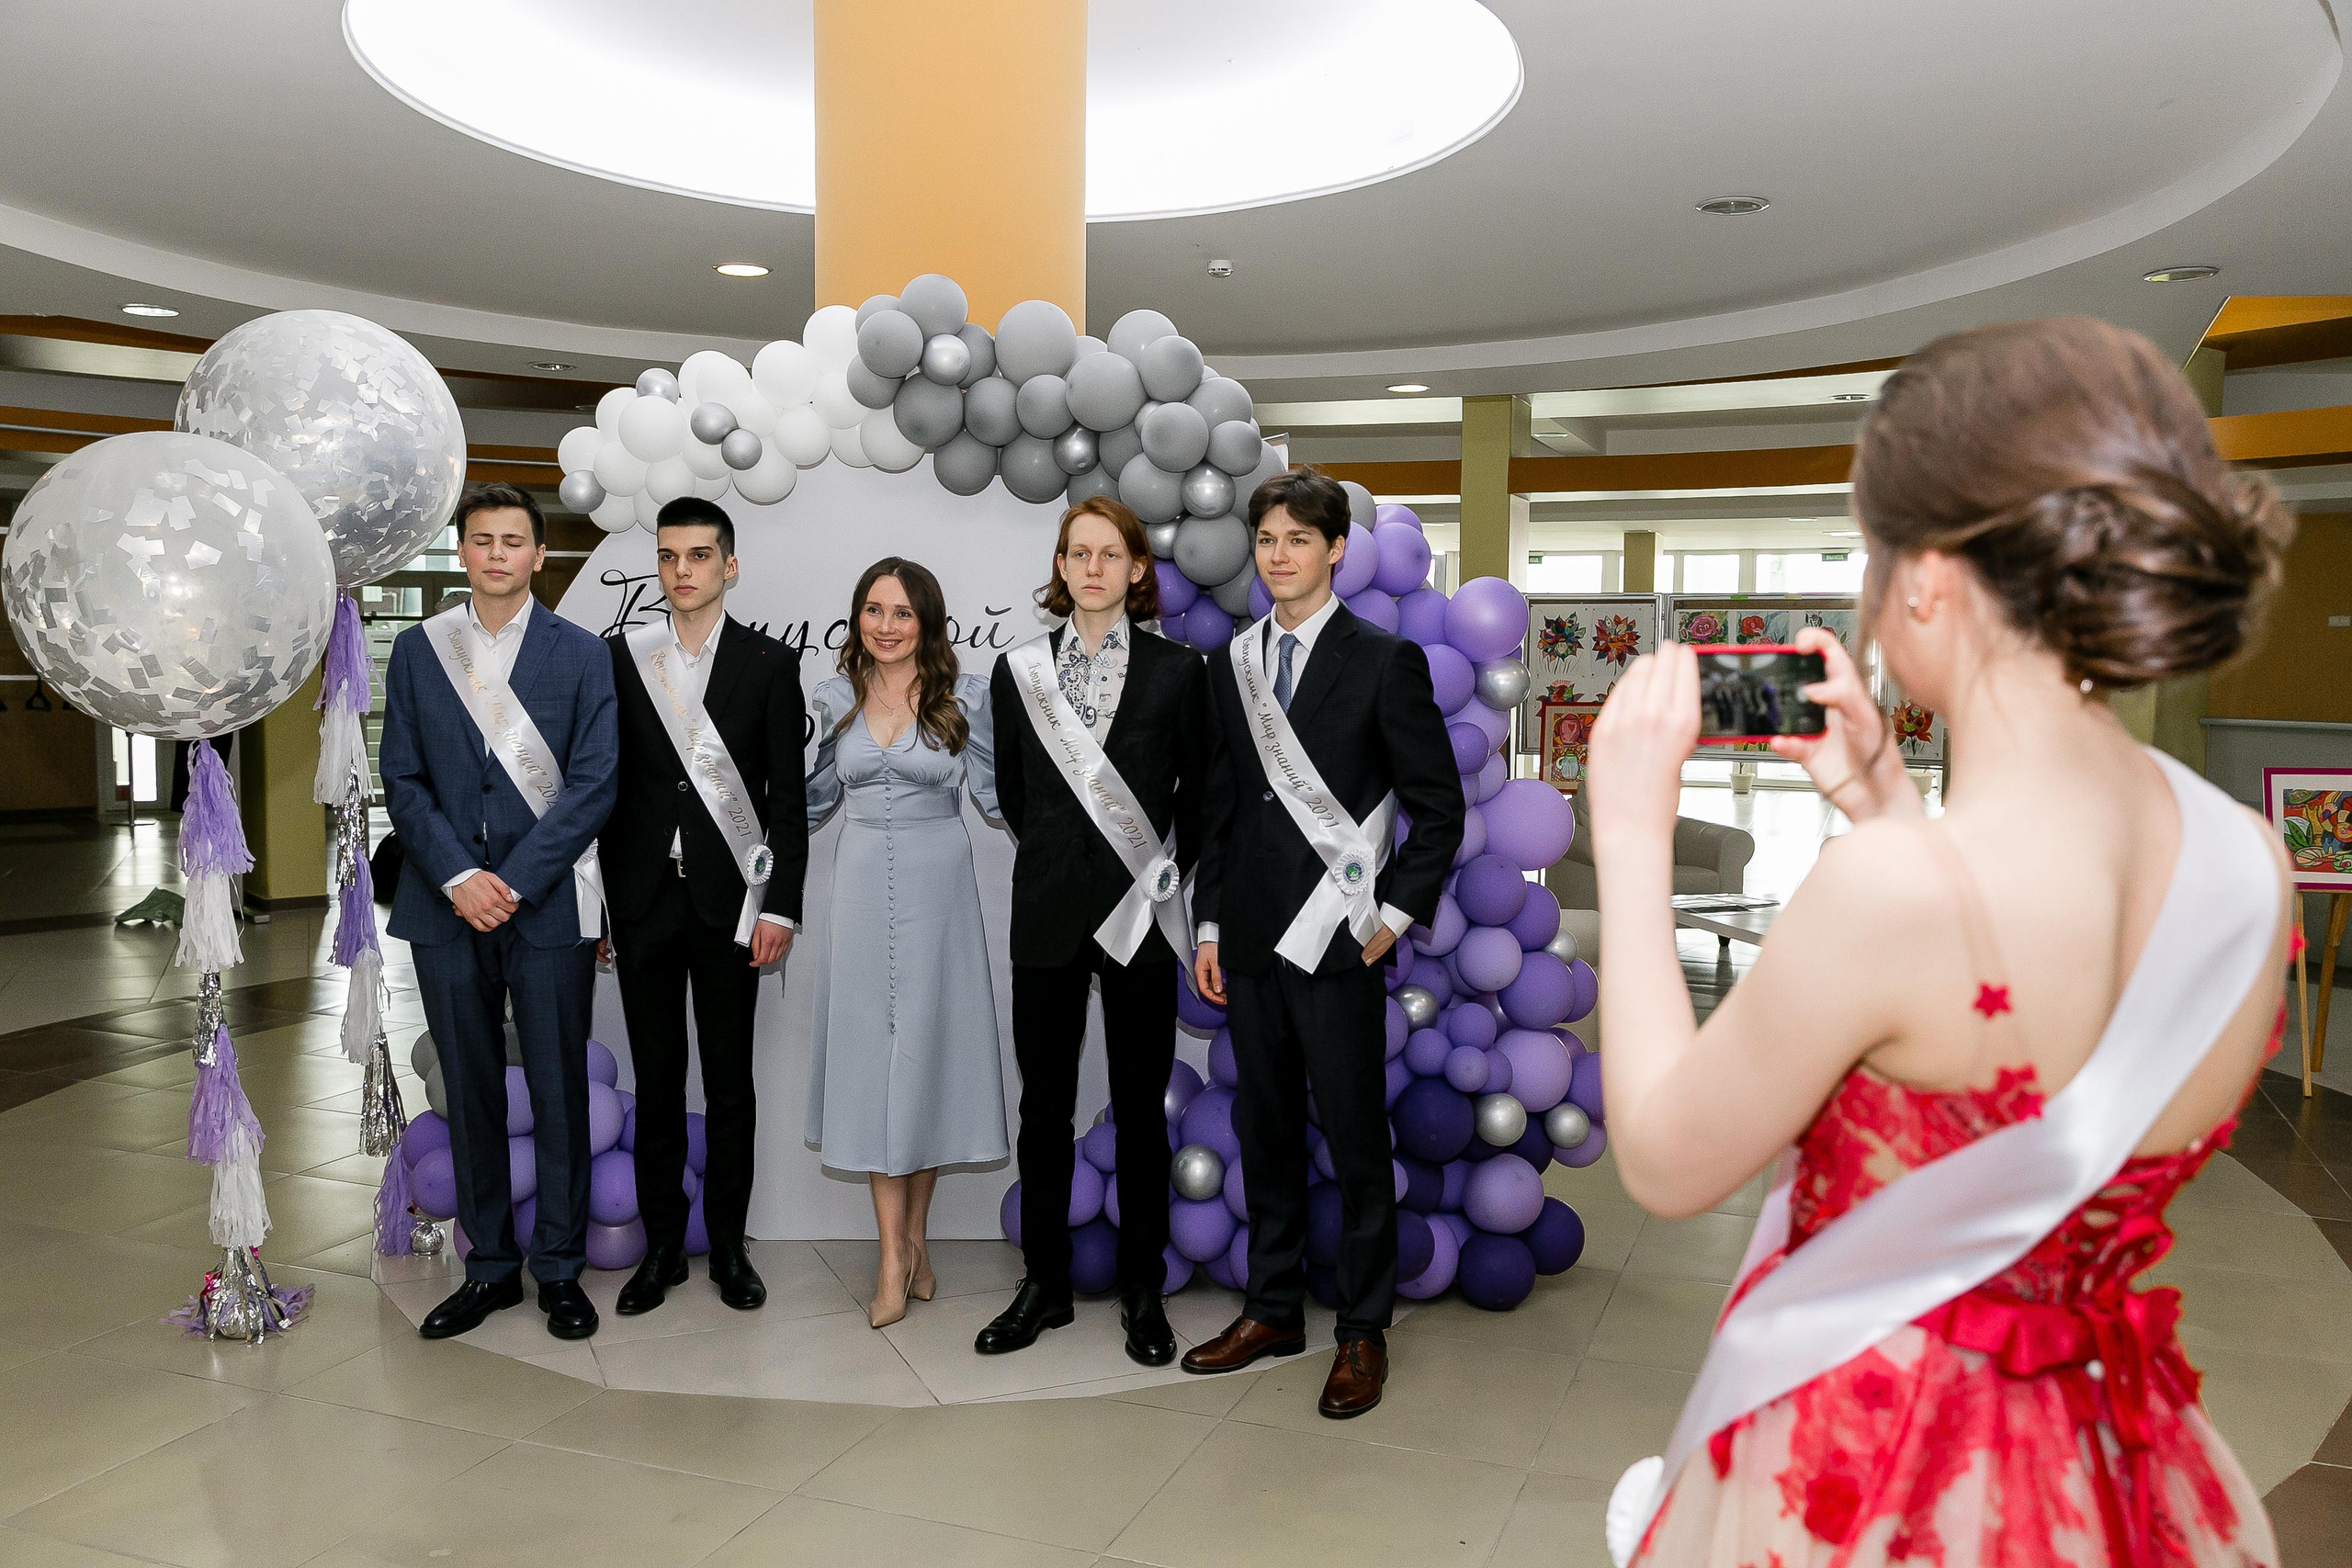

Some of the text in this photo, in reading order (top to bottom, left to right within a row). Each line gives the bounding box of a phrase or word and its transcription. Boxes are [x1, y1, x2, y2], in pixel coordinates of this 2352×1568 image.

[1027, 662, 1061, 730] Выпускник
[1117, 817, 1148, 850] 2021
[1238, 634, 1260, 705] Выпускник
[1305, 796, 1340, 831] 2021
[536, 781, 560, 808] 202
[728, 807, 752, 838] 2021
